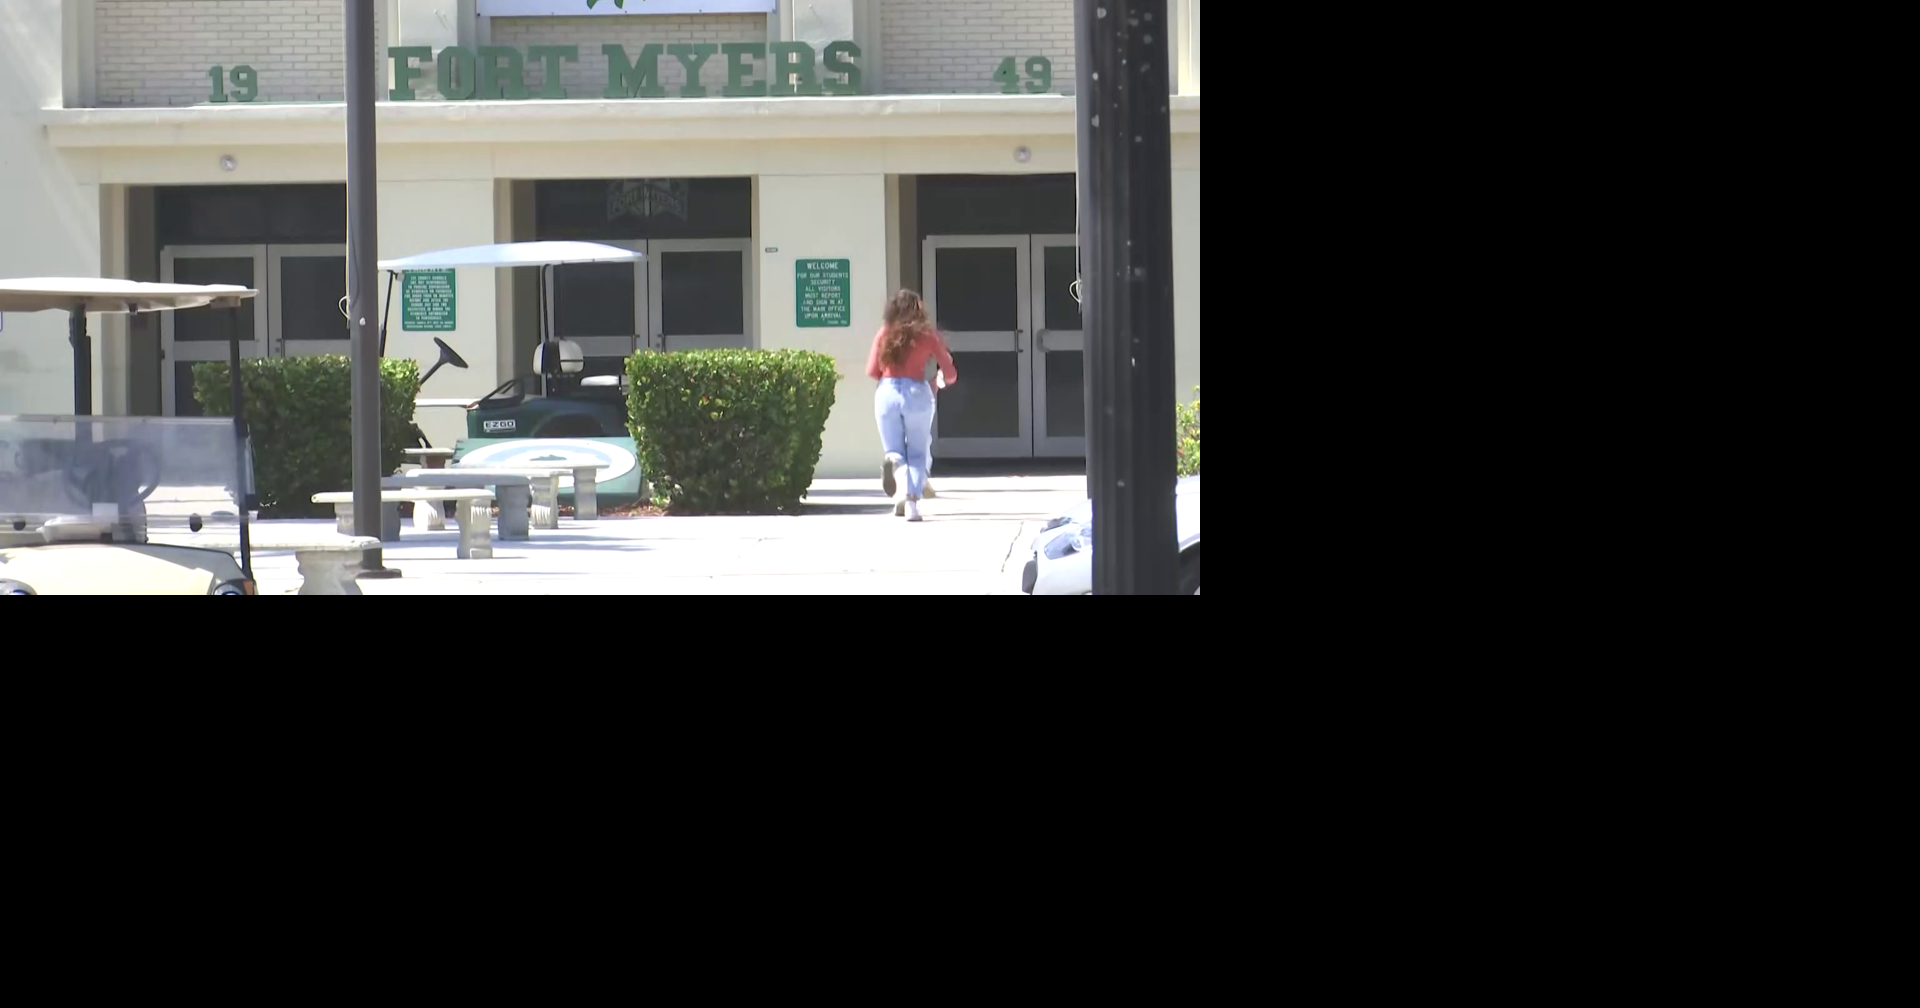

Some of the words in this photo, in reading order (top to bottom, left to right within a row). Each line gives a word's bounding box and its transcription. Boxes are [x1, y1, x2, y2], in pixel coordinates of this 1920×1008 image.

[208, 65, 258, 103] 19
[388, 46, 578, 100] FORT
[602, 41, 862, 98] MYERS
[993, 56, 1051, 94] 49
[806, 262, 839, 270] WELCOME
